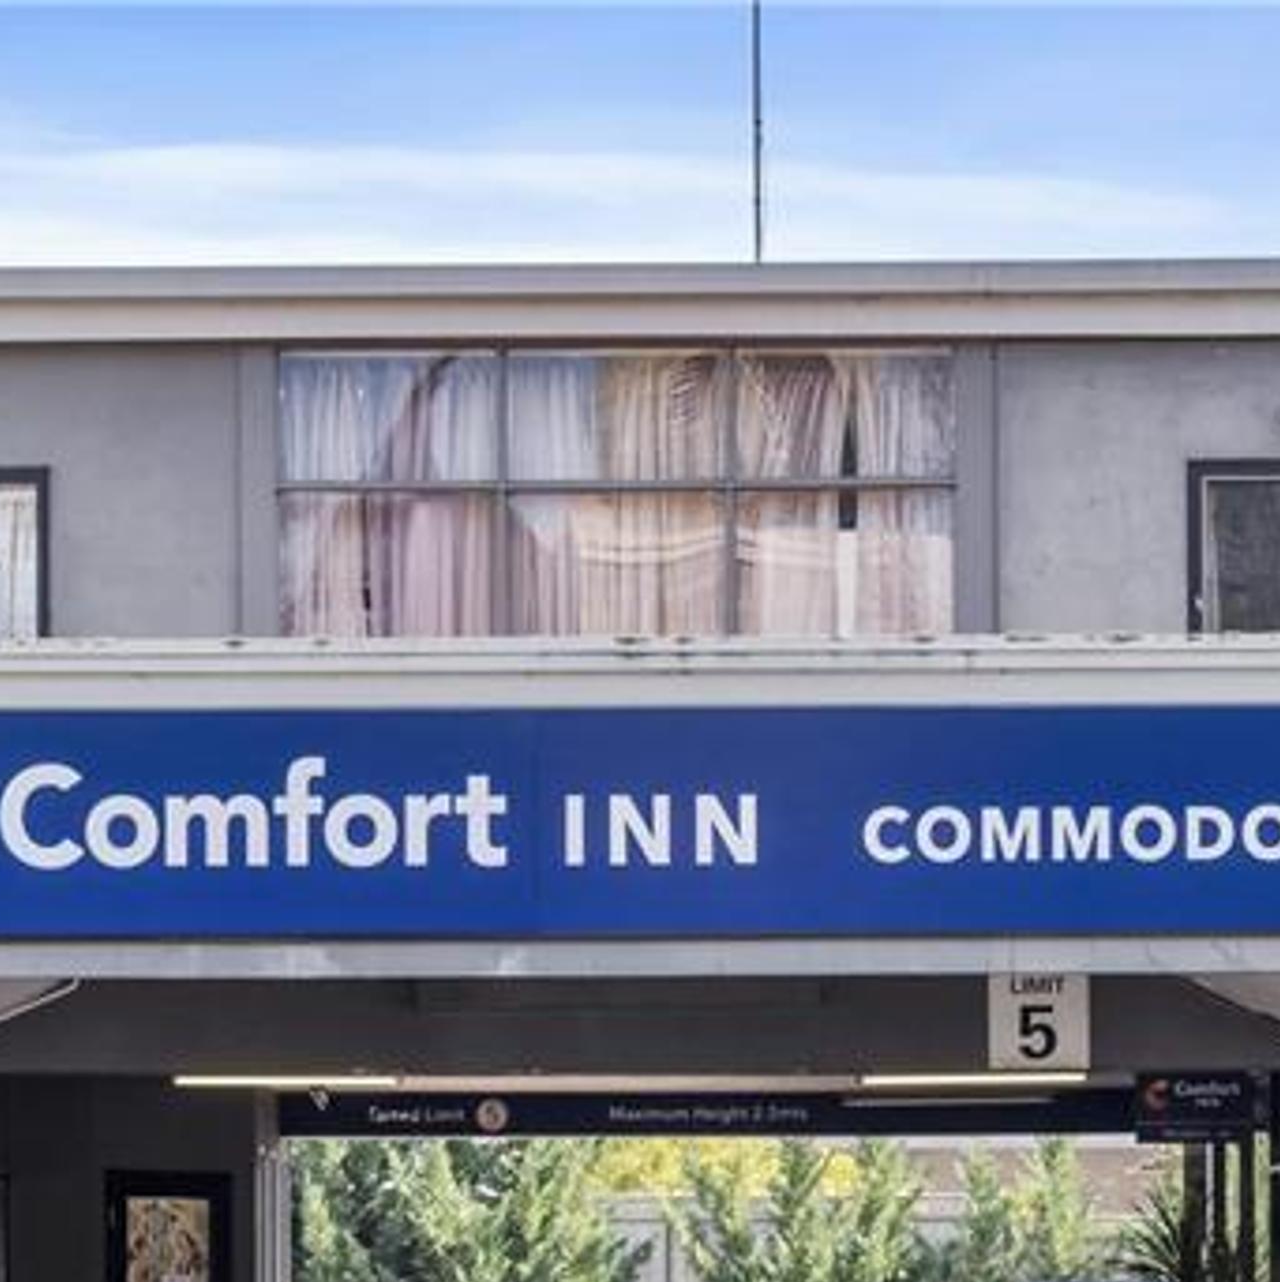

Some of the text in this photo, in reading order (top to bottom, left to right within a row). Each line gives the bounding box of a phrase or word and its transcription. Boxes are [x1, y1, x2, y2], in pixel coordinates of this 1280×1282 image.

[0, 757, 507, 870] Comfort
[564, 794, 758, 866] INN
[1019, 1004, 1057, 1060] 5
